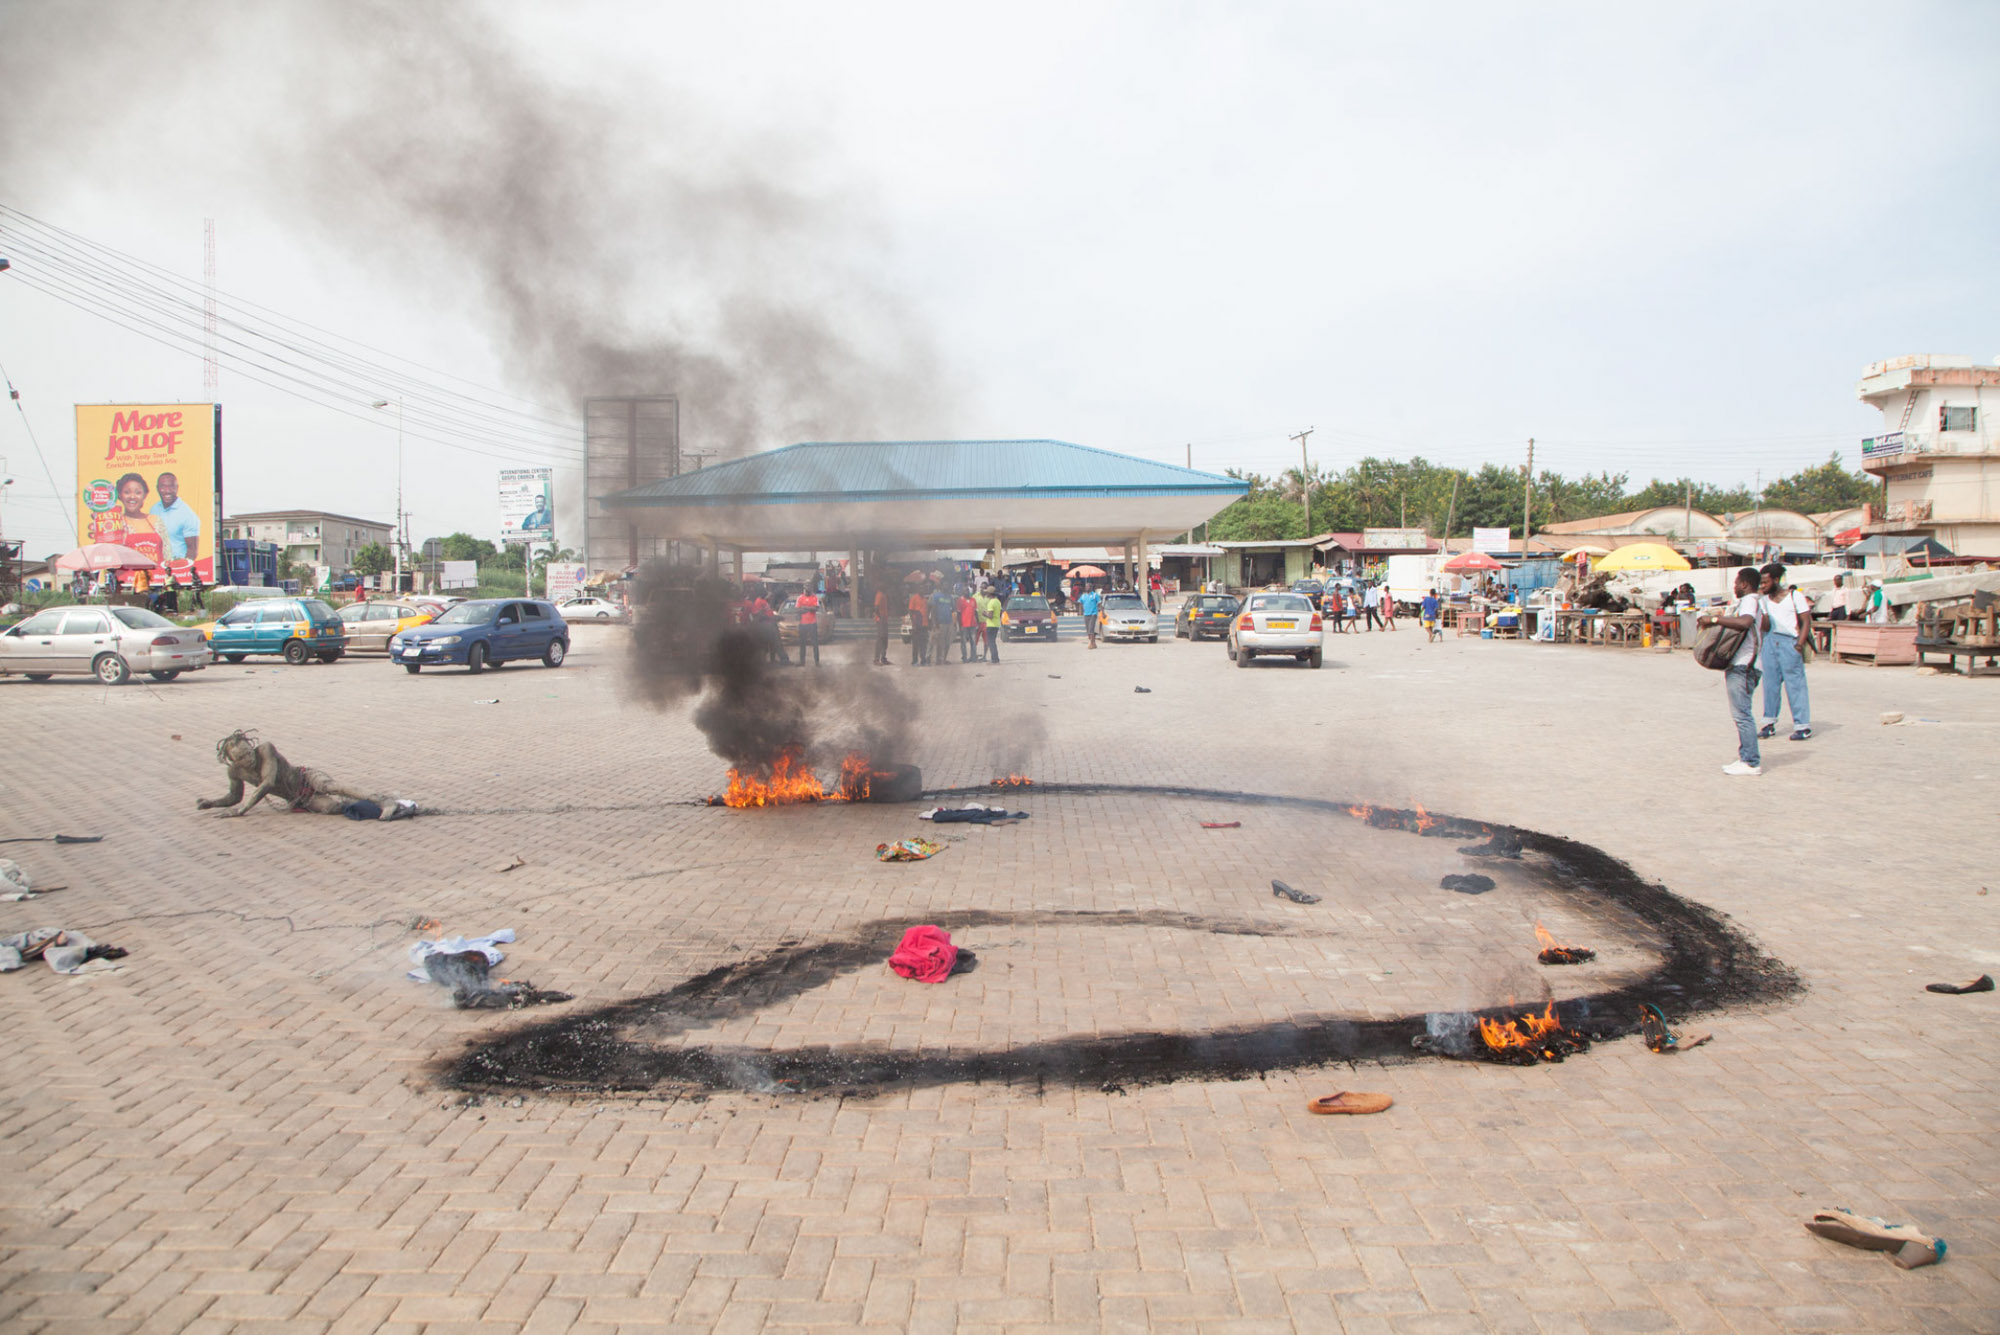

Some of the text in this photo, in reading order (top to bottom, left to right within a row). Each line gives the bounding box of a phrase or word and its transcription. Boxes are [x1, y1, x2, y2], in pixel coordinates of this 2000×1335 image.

[111, 410, 183, 433] More
[134, 453, 151, 461] Tasty
[106, 461, 135, 469] Enriched
[98, 511, 121, 520] TASTY
[97, 520, 121, 532] TOM
